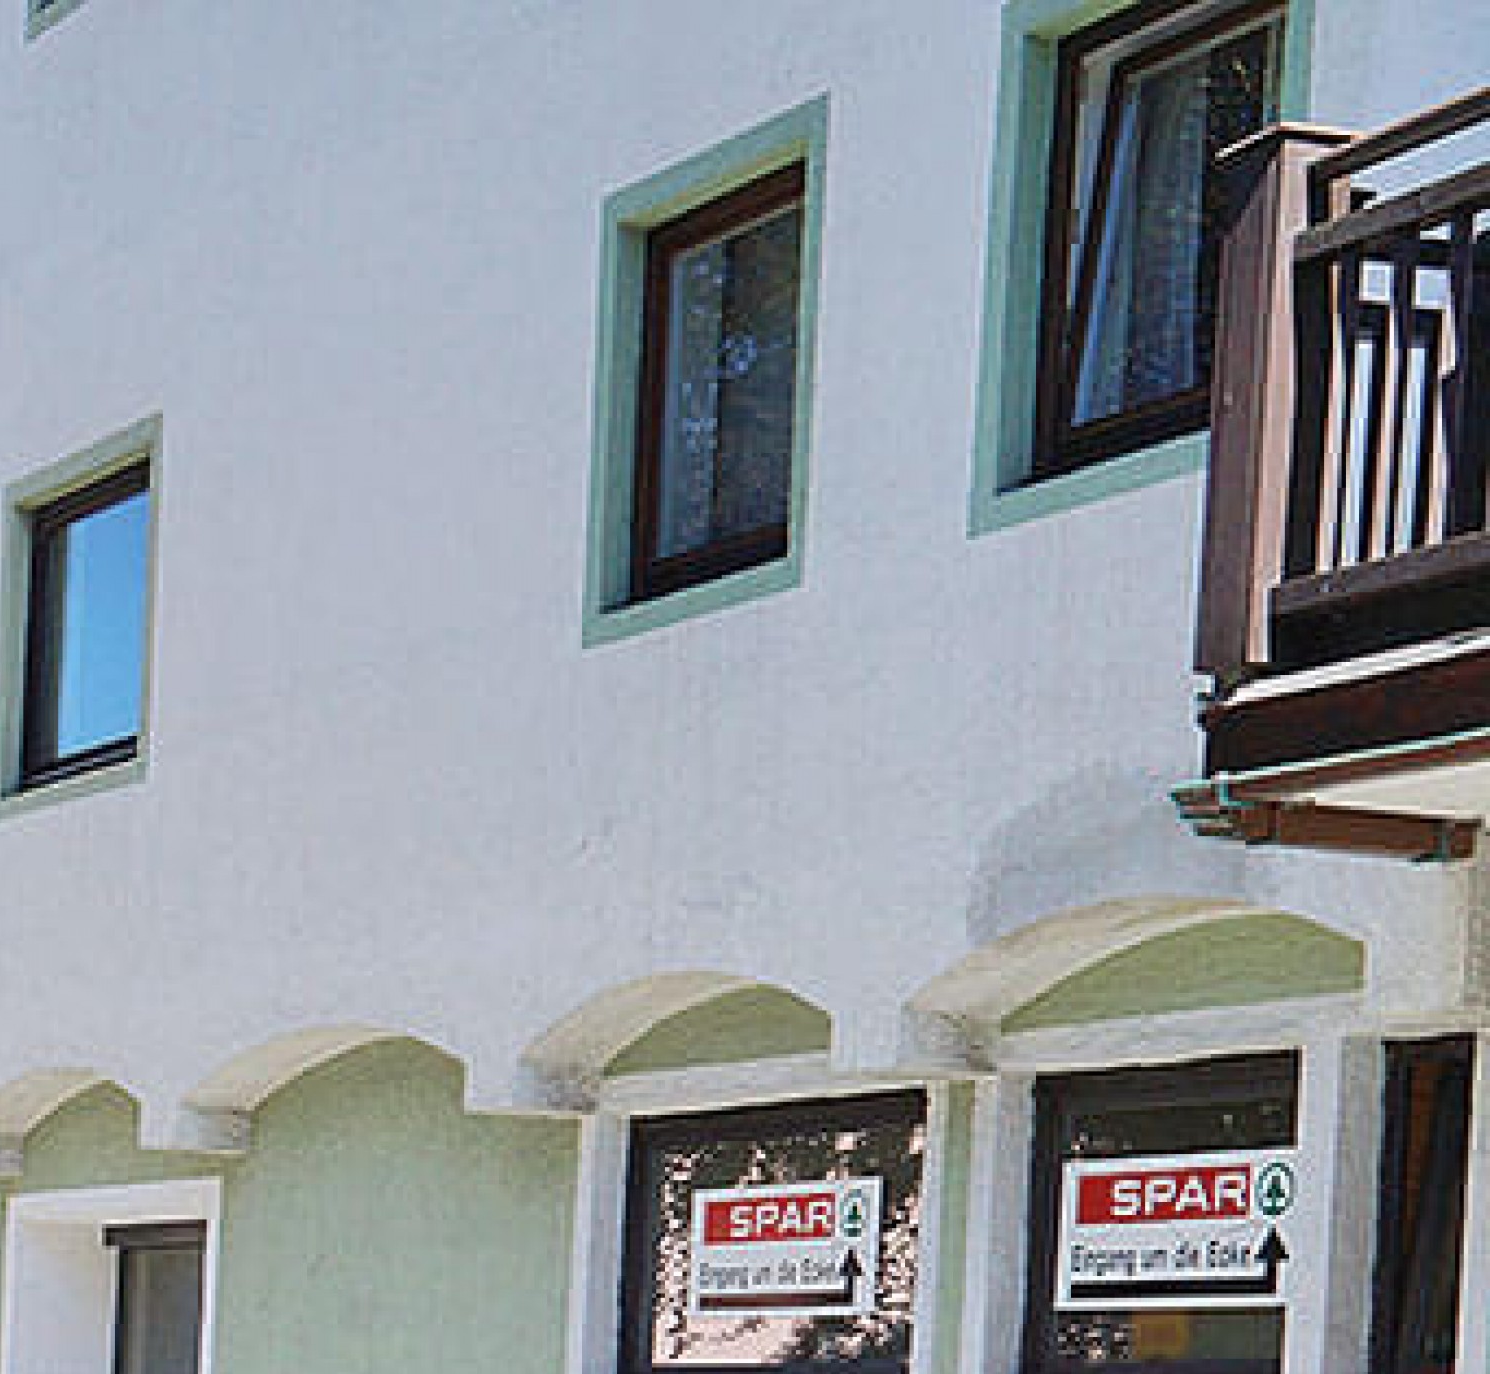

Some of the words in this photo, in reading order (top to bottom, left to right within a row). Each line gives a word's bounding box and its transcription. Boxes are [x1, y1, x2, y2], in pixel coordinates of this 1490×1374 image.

[1110, 1175, 1247, 1216] SPAR
[729, 1201, 832, 1238] SPAR
[699, 1262, 749, 1290] Eingang
[751, 1266, 771, 1286] um
[777, 1258, 797, 1286] die
[1070, 1244, 1136, 1277] Eingang
[1140, 1249, 1167, 1269] um
[1174, 1240, 1199, 1269] die
[1205, 1239, 1252, 1271] Ecke
